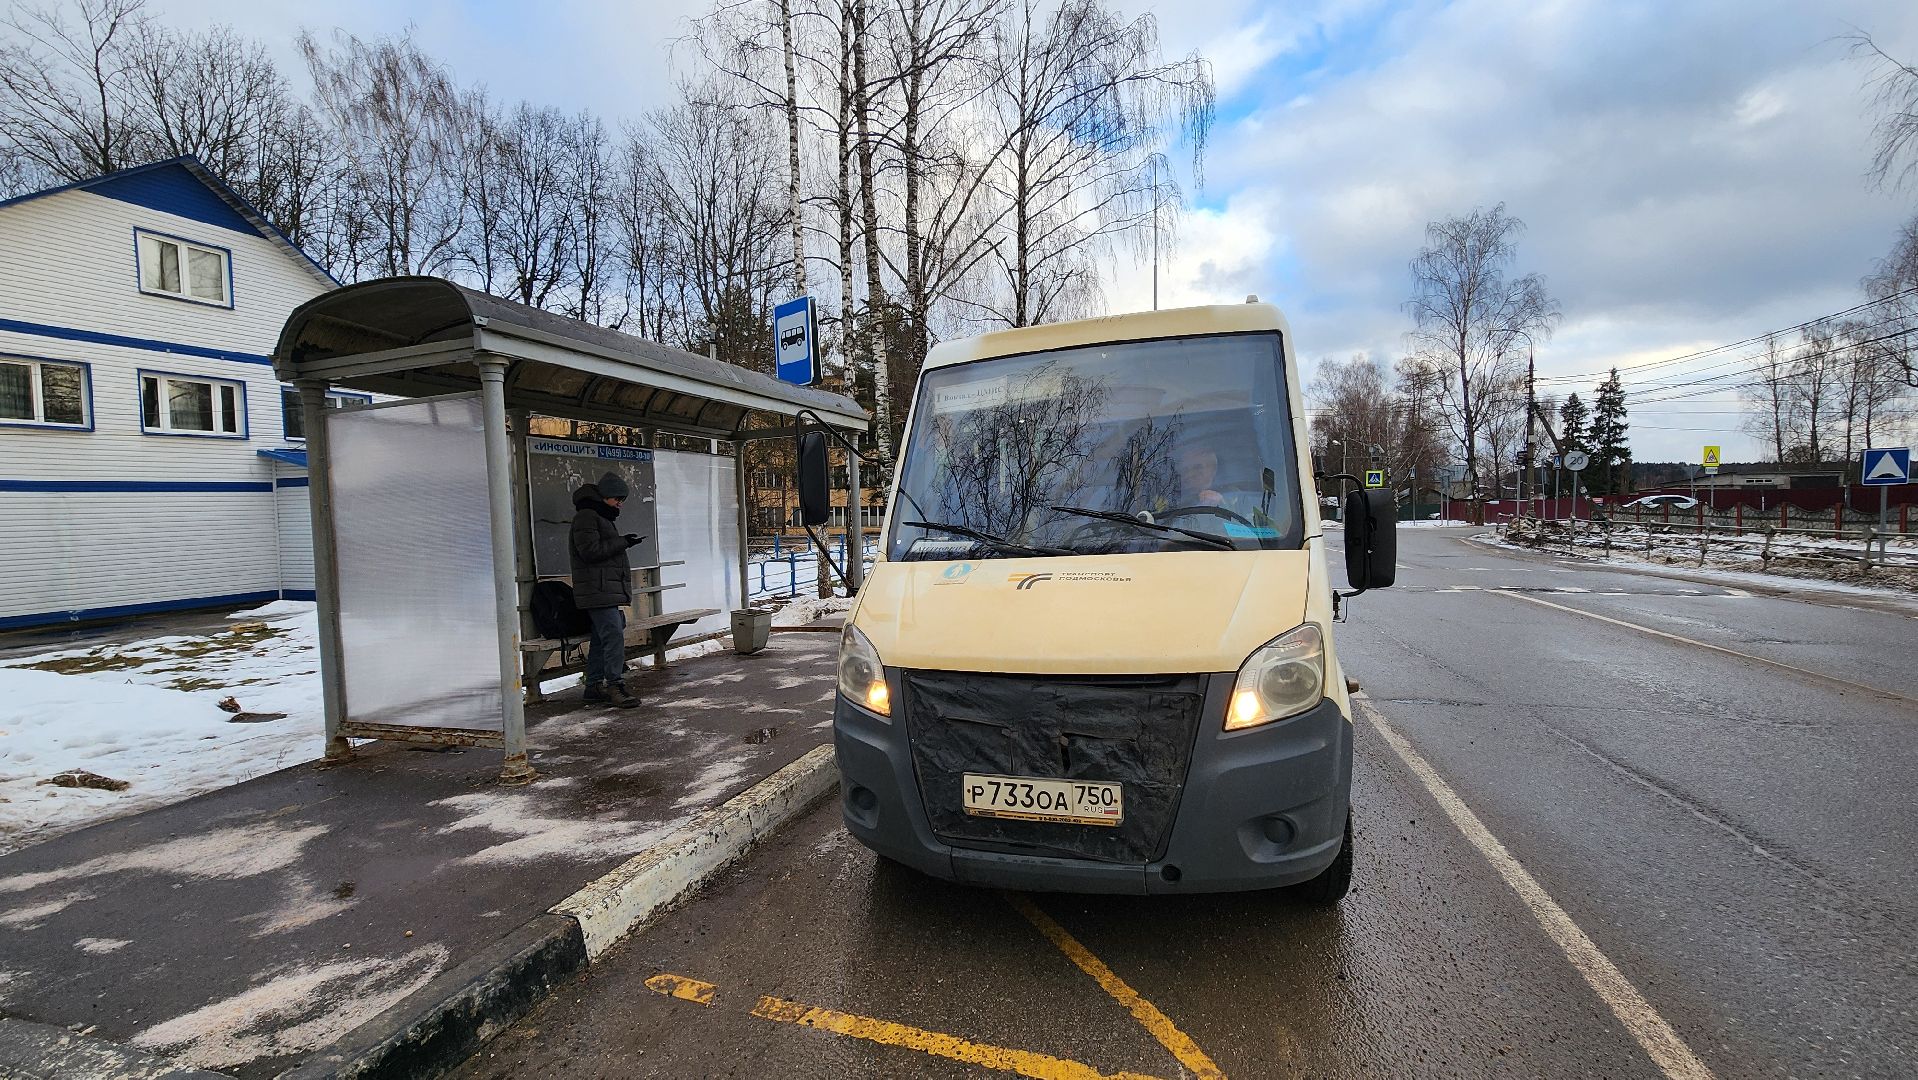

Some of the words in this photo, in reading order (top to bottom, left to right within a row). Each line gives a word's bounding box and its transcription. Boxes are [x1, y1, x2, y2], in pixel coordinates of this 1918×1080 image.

[534, 441, 596, 456] «ИНФОЩИТ»
[605, 446, 622, 458] (495)
[1570, 456, 1583, 465] 20
[1074, 785, 1114, 806] 750
[1083, 805, 1103, 814] RUS
